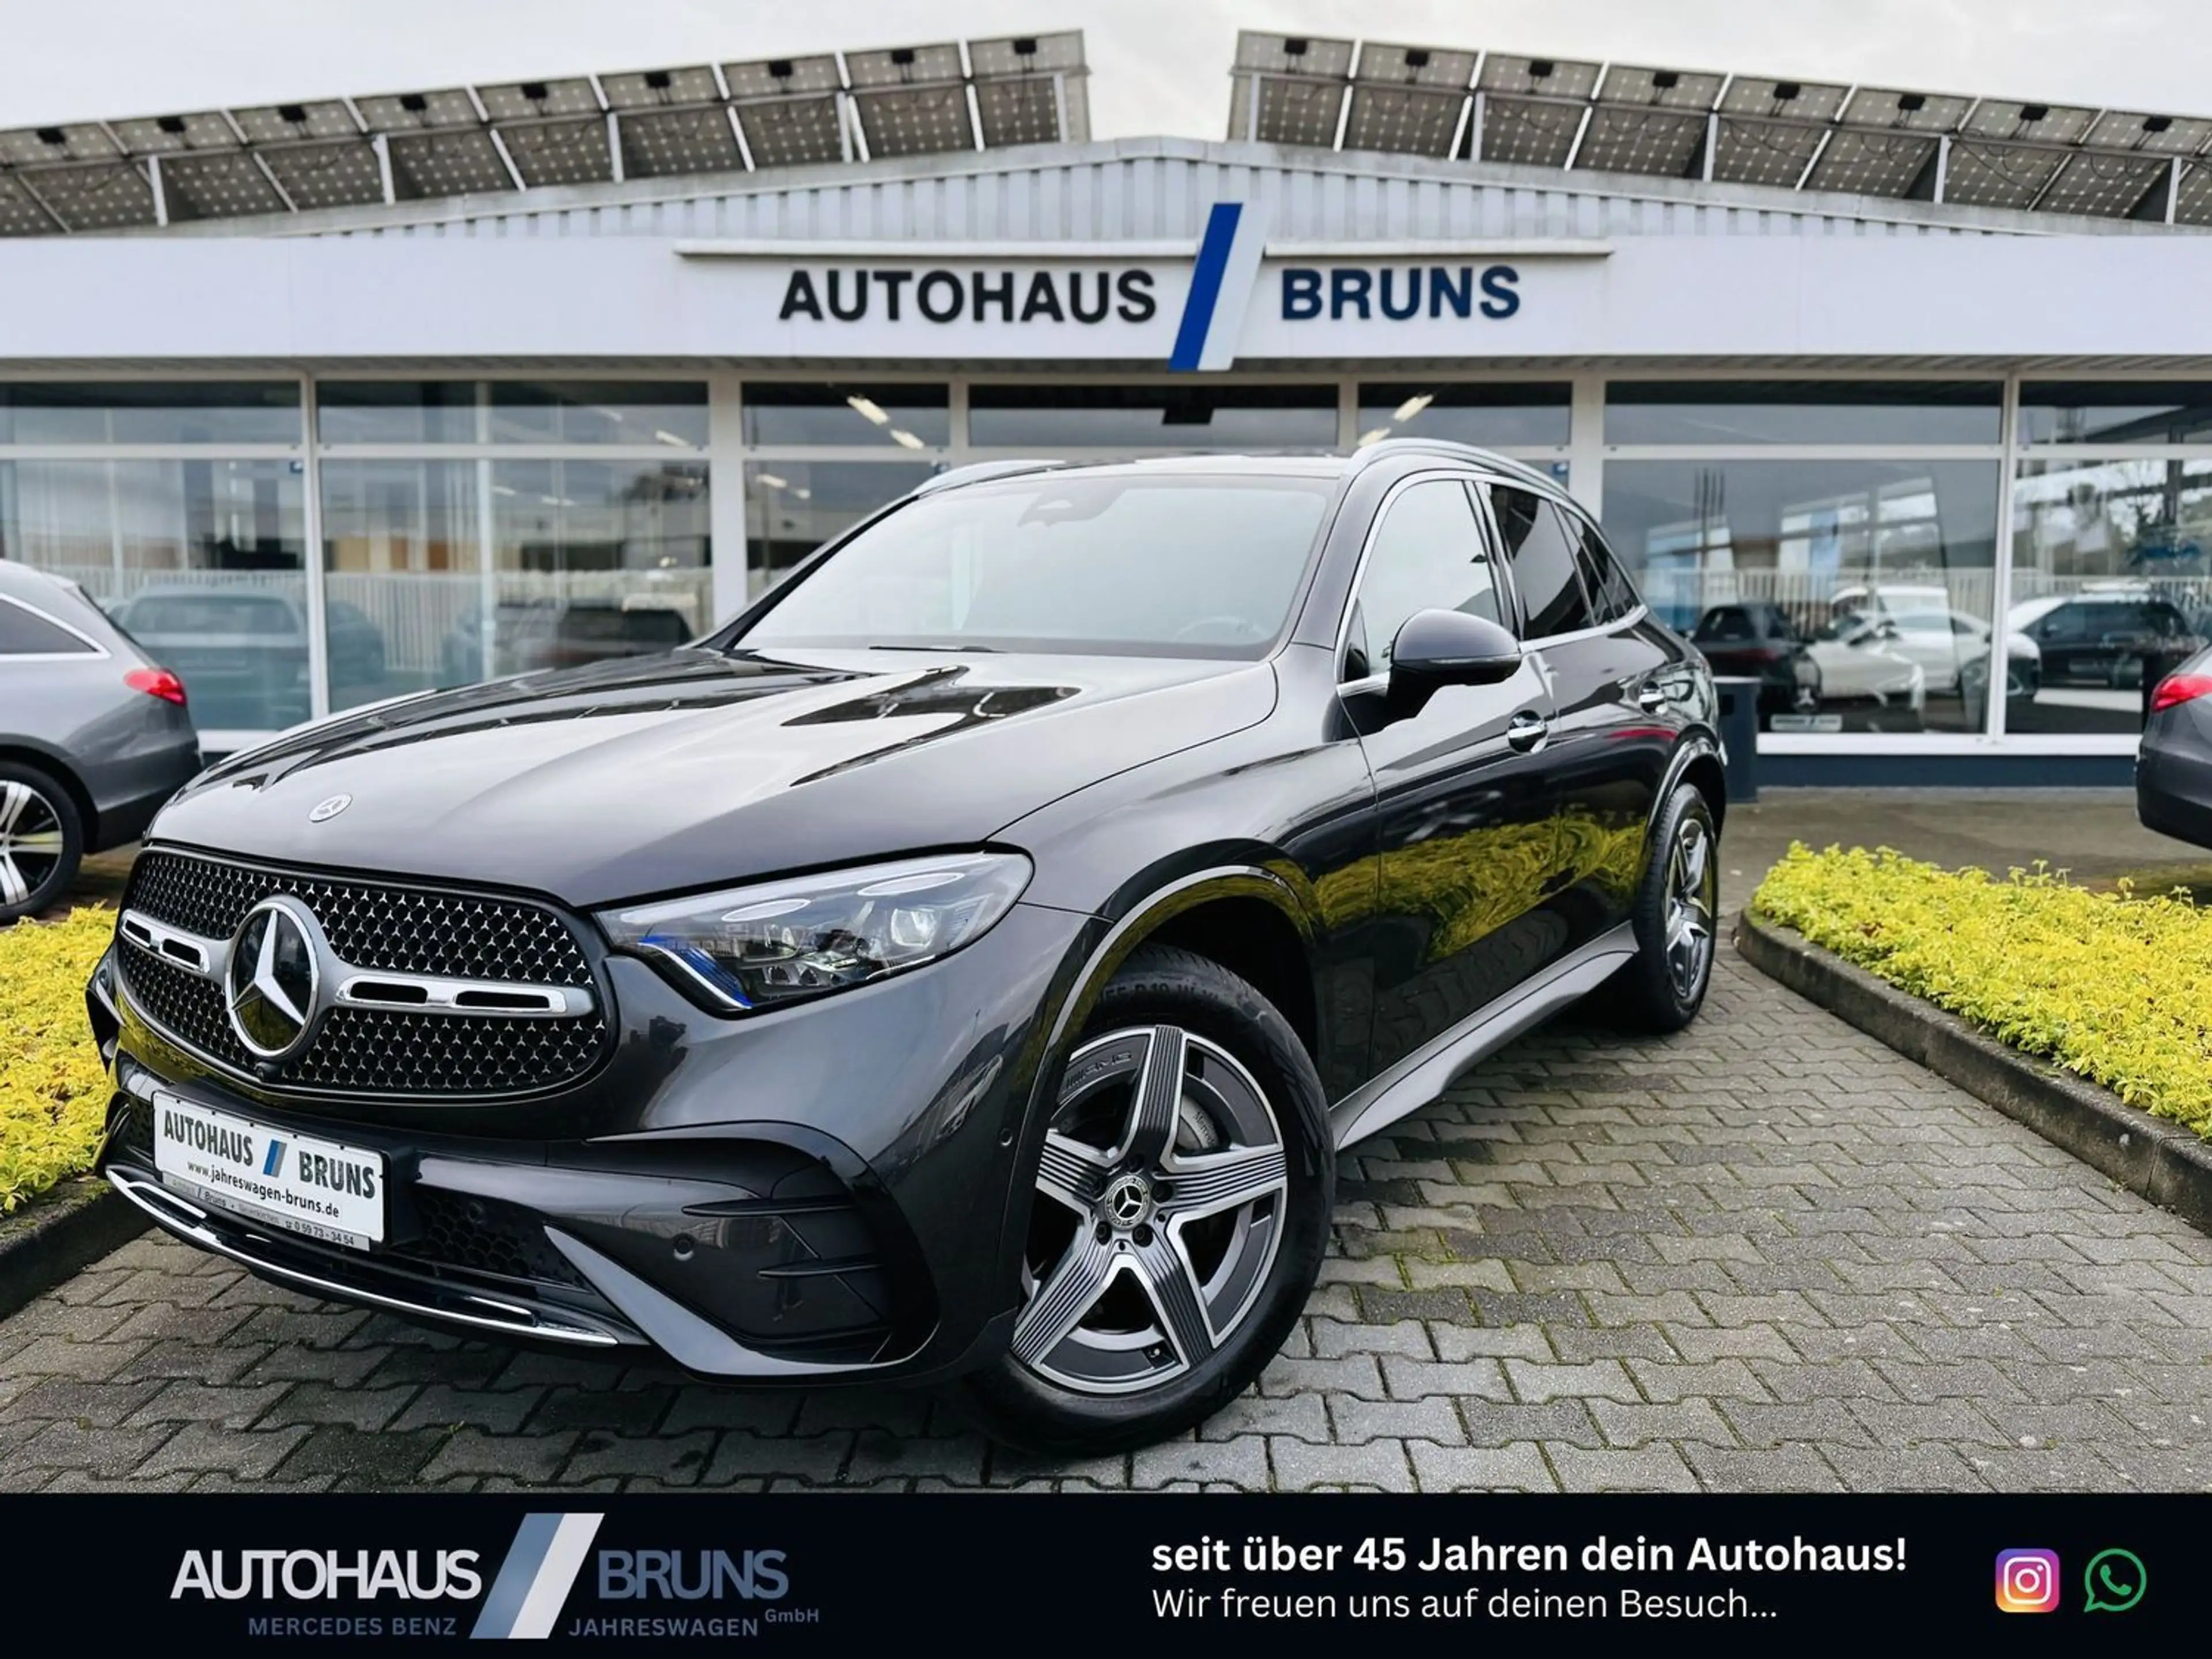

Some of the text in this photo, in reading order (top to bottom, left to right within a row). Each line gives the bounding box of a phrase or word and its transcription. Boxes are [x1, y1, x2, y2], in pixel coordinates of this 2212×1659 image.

[779, 266, 1521, 324] AUTOHAUS BRUNS
[164, 1110, 375, 1198] AUTOHAUS BRUNS
[187, 1161, 339, 1218] www.jahreswagen-bruns.de
